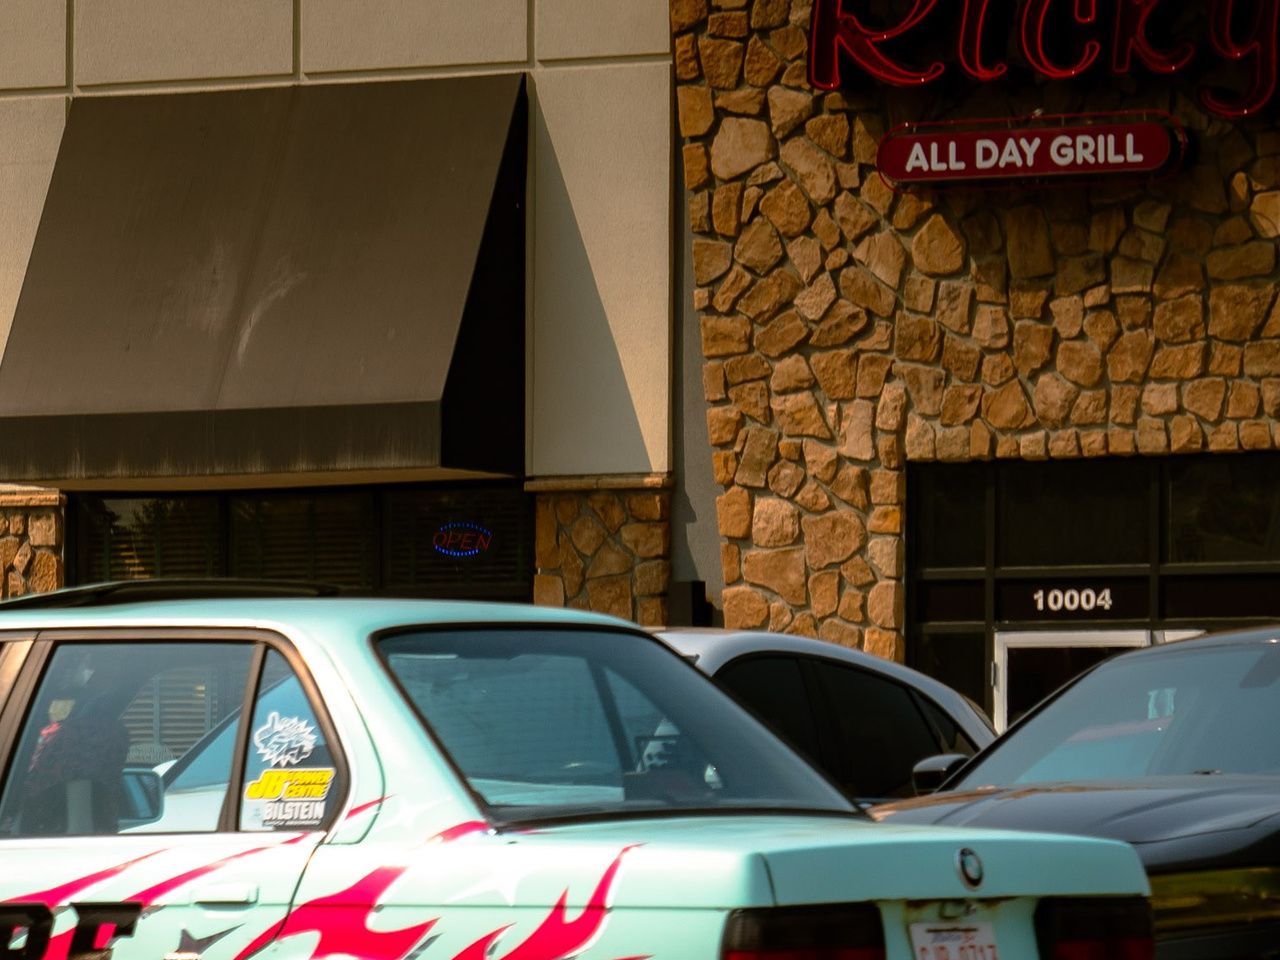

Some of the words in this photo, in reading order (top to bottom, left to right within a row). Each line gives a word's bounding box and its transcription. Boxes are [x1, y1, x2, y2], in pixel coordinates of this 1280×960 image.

[905, 141, 966, 173] ALL
[975, 136, 1041, 170] DAY
[1049, 132, 1144, 166] GRILL
[432, 530, 492, 551] OPEN
[1033, 587, 1113, 611] 10004
[263, 801, 326, 820] BILSTEIN
